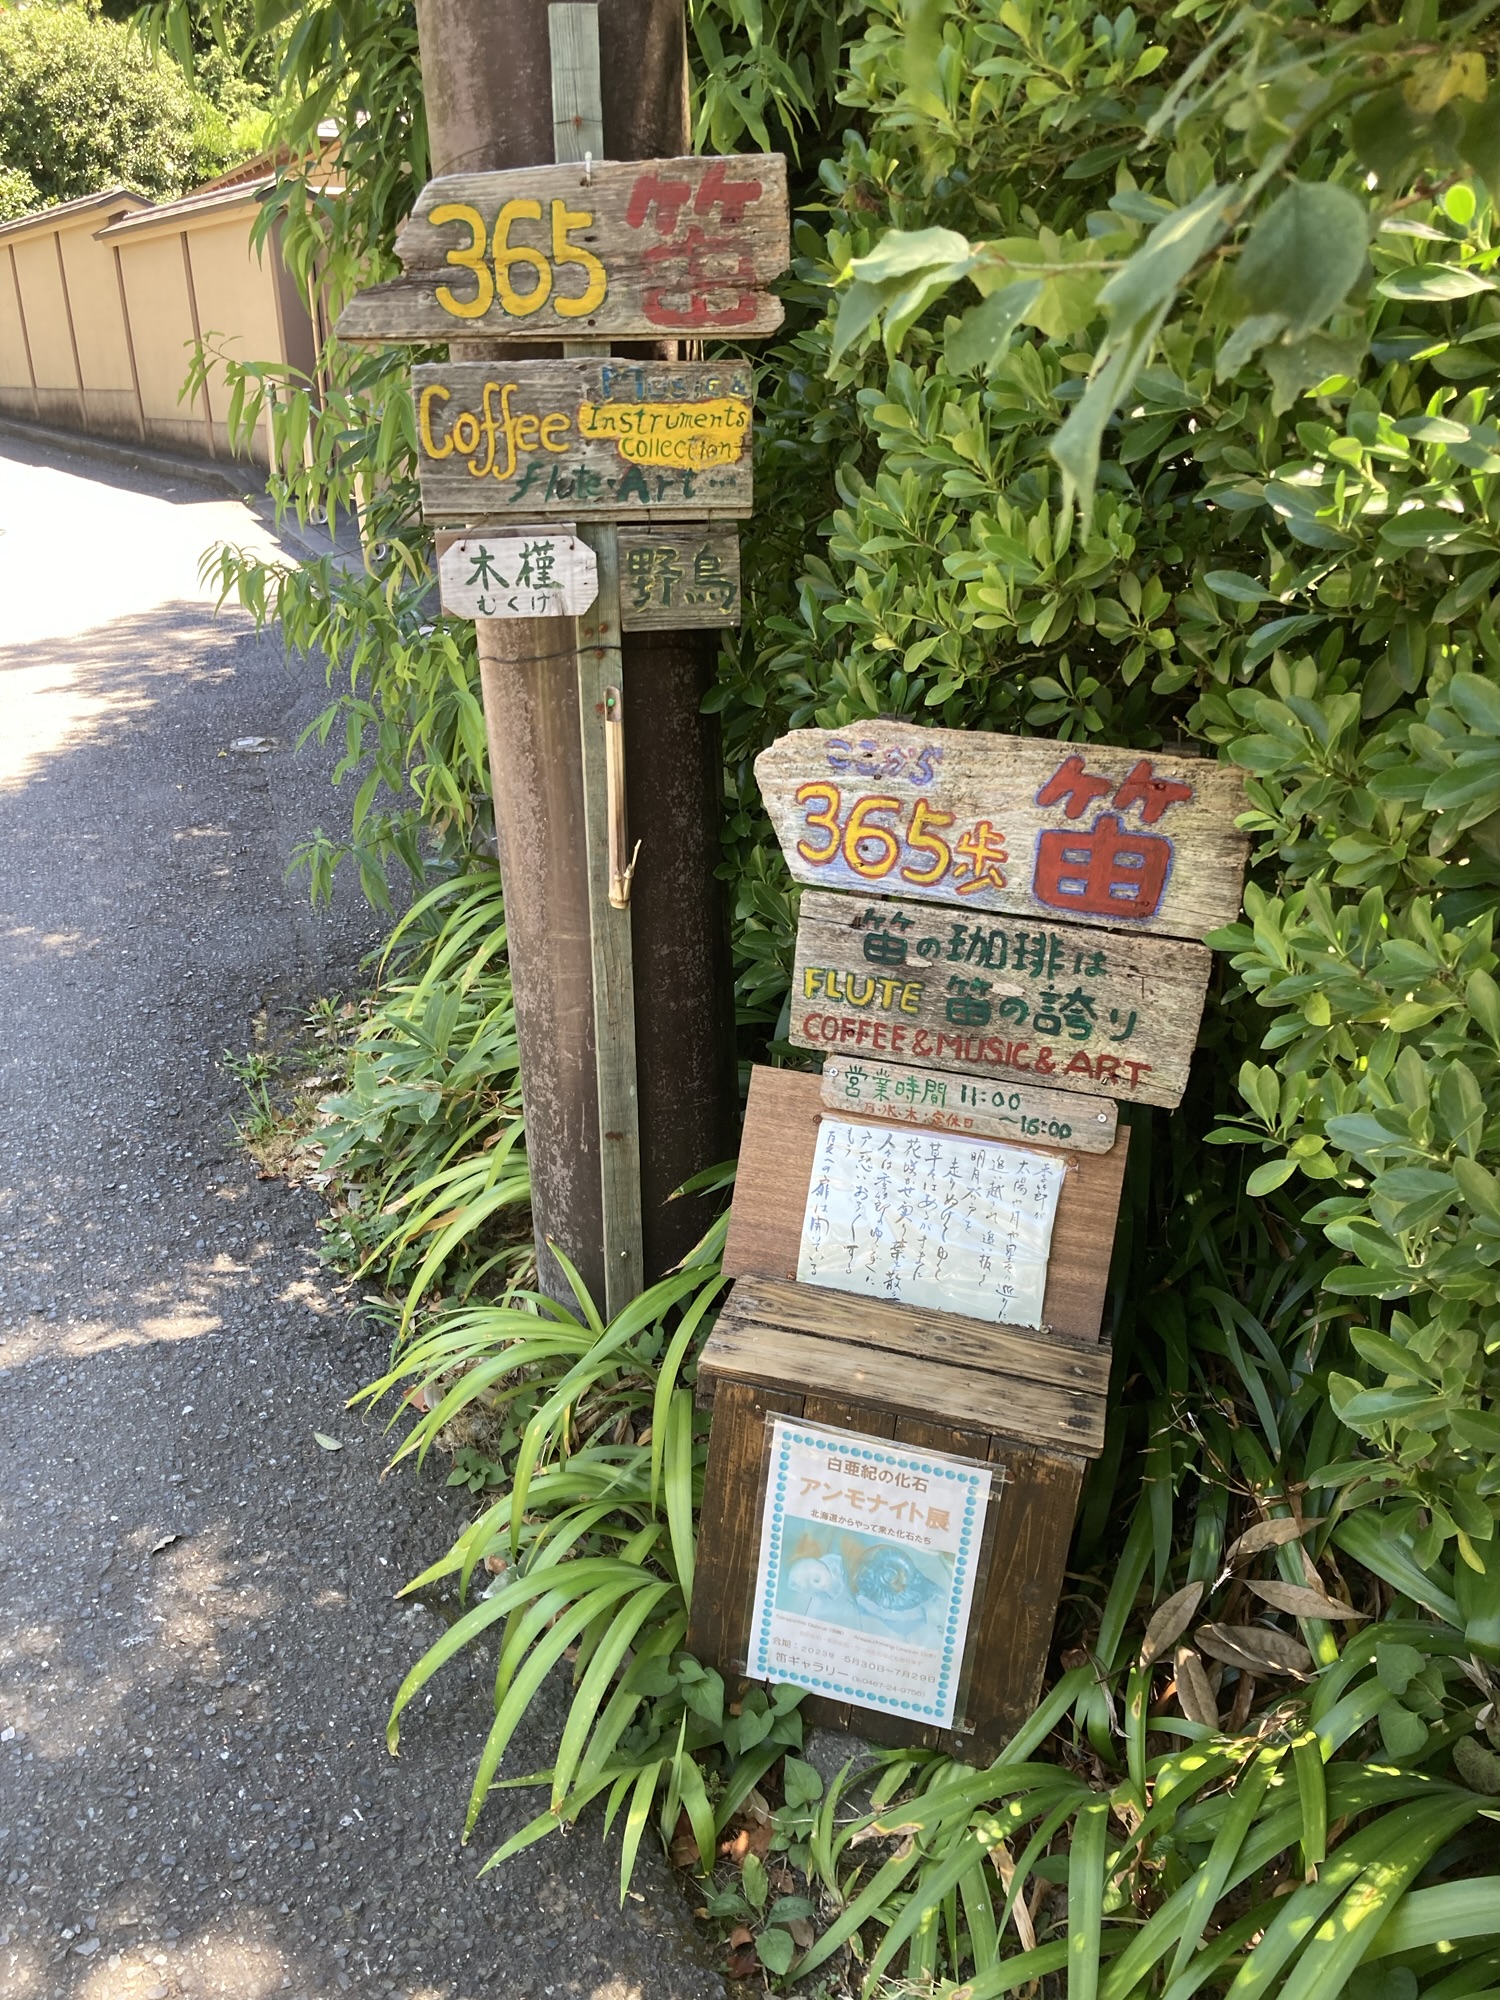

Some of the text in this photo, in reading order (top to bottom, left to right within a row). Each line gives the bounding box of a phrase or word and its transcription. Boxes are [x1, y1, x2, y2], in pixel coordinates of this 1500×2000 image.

[428, 199, 607, 318] 365
[626, 162, 763, 328] 笛
[602, 365, 722, 400] Music
[419, 382, 572, 481] Coffee
[587, 406, 747, 434] Instruments
[464, 540, 565, 592] 木槿
[626, 542, 738, 614] 野鳥
[1033, 753, 1194, 922] 笛
[861, 907, 1108, 980] 笛の珈琲は
[803, 966, 1138, 1042] FLUTE 笛の誇り
[844, 1065, 1021, 1110] 営業時間 11:00
[827, 1457, 929, 1493] 白亜紀の化石
[800, 1476, 950, 1532] アンモナイト展
[810, 1508, 931, 1545] 北海道からやって来た化石たち
[775, 1651, 849, 1677] 笛ギャラリー
